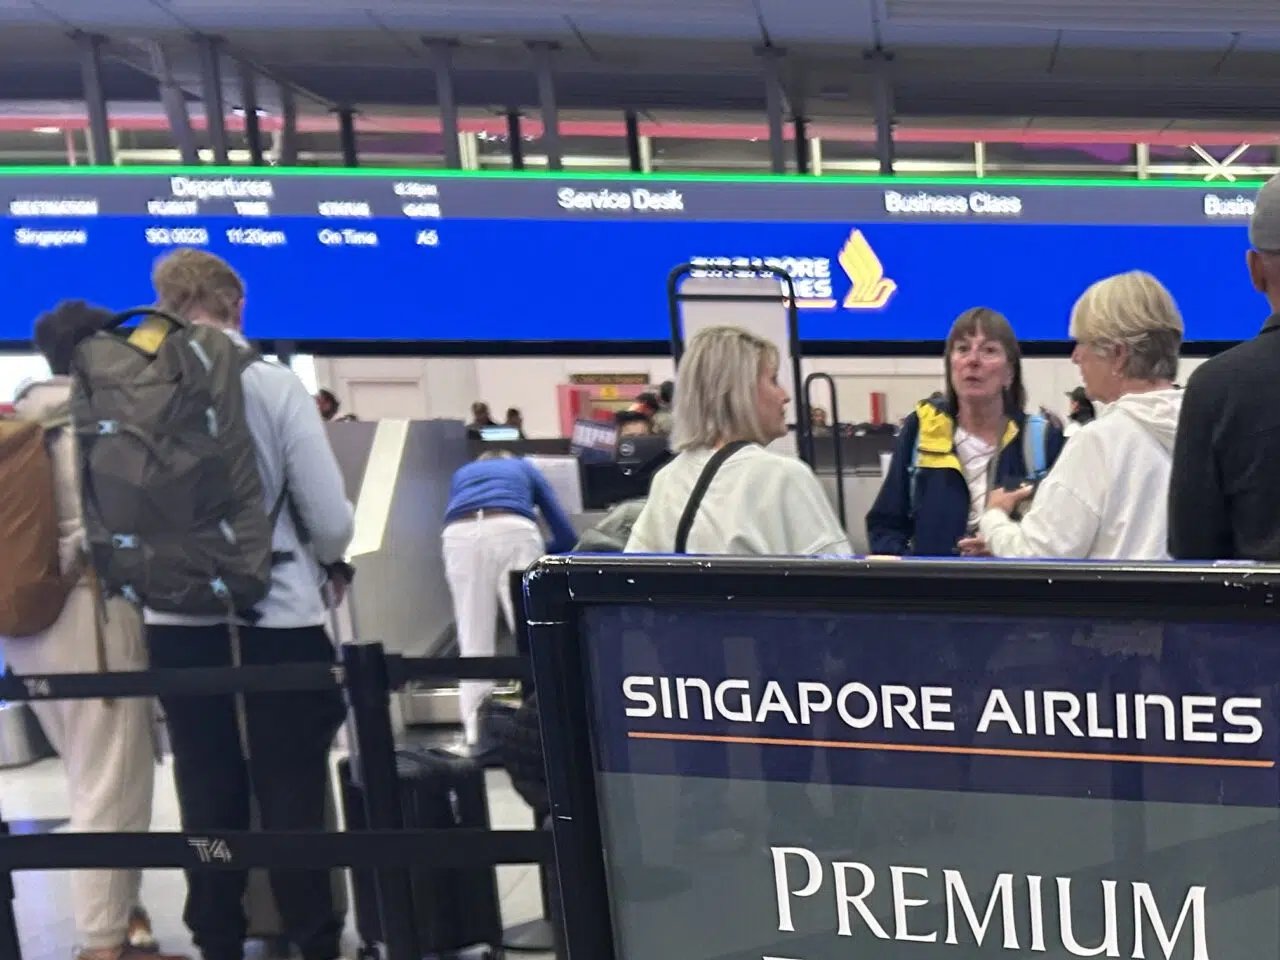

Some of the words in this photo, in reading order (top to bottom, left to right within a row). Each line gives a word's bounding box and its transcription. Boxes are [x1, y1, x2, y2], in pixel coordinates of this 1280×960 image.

[171, 177, 273, 199] Departures
[558, 187, 630, 210] Service
[632, 188, 684, 211] Desk
[884, 190, 968, 213] Business
[969, 191, 1022, 213] Class
[1204, 194, 1256, 216] Busin
[15, 228, 88, 247] Singapore
[318, 229, 342, 246] On
[342, 229, 378, 246] Time
[622, 675, 955, 731] SINGAPORE
[977, 689, 1263, 744] AIRLINES
[187, 836, 232, 863] T4
